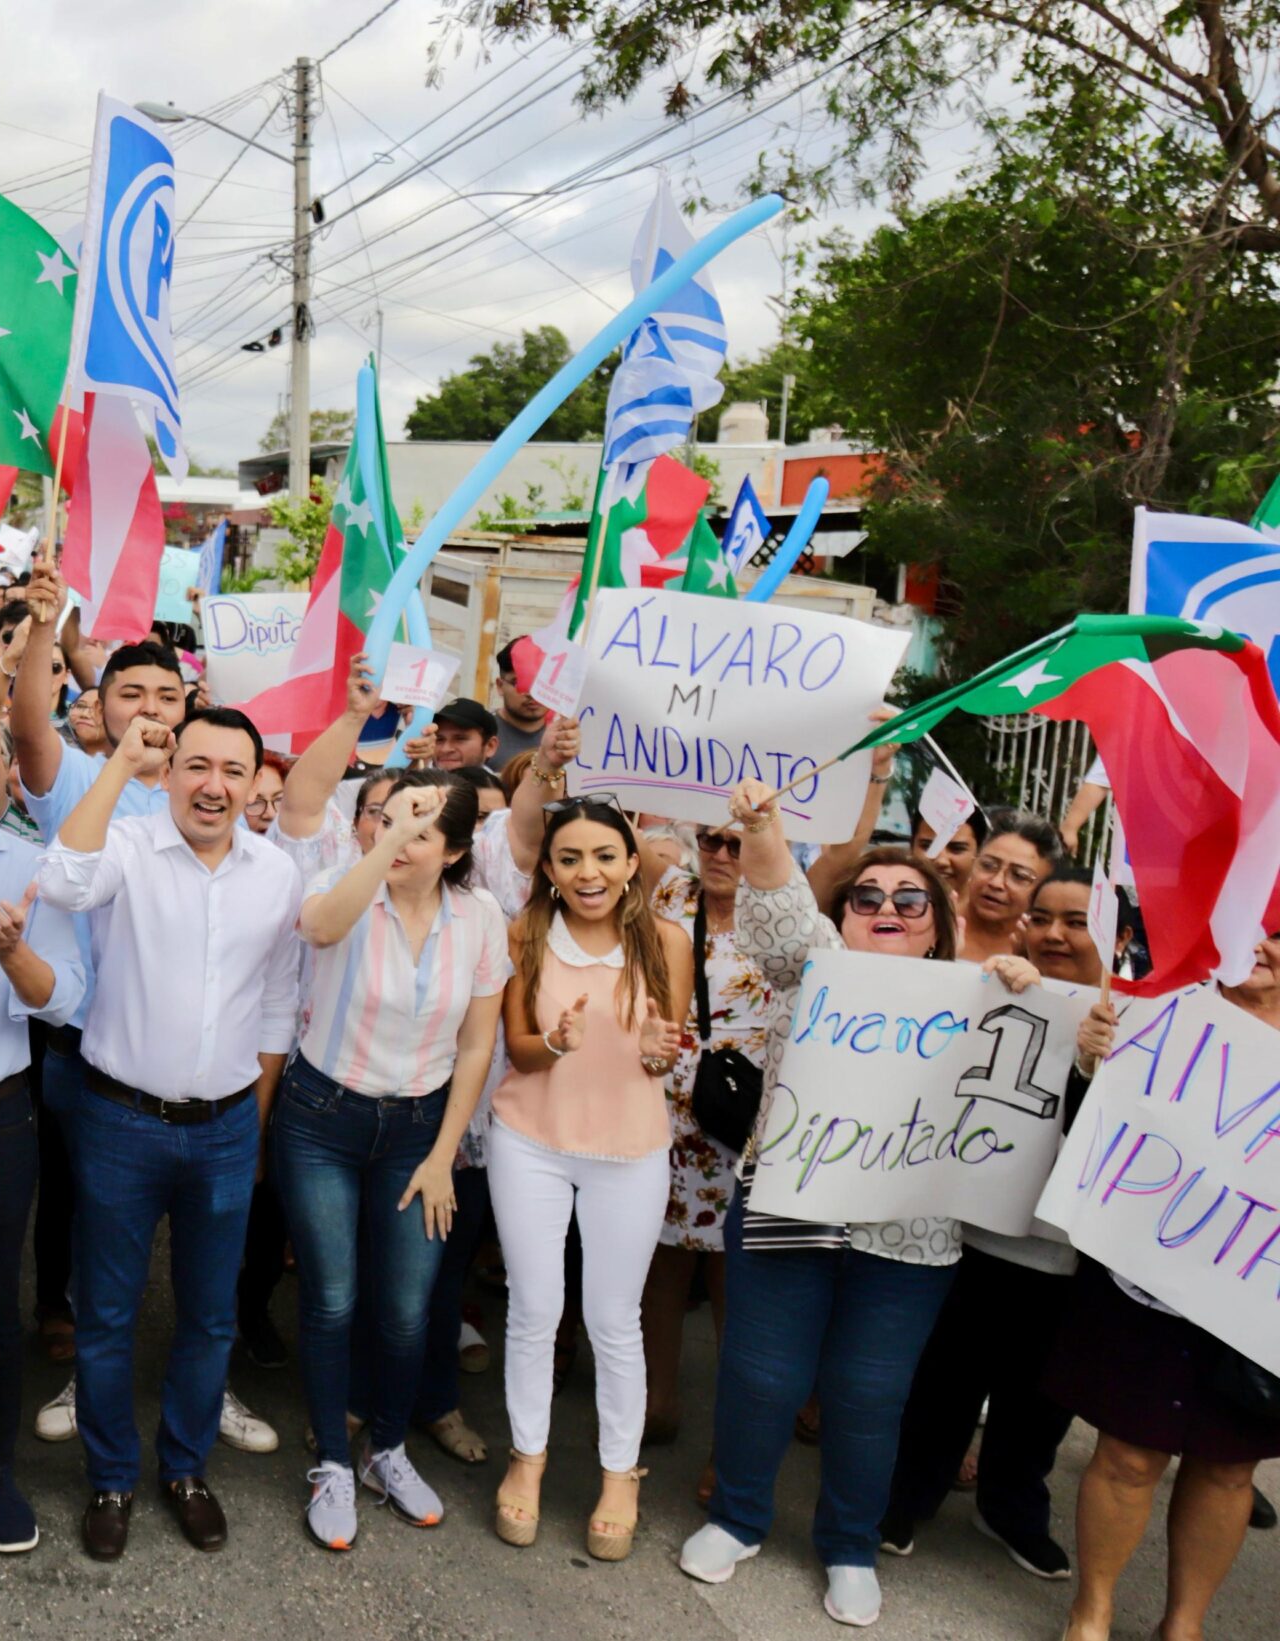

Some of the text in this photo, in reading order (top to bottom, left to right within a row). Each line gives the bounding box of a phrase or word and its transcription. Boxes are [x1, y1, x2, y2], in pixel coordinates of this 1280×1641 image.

[410, 656, 428, 688] 1
[550, 651, 568, 686] 1
[601, 596, 845, 692] ÁLVARO
[666, 683, 718, 722] MI
[575, 706, 819, 803] CANDIDATO
[954, 1003, 1061, 1120] 1
